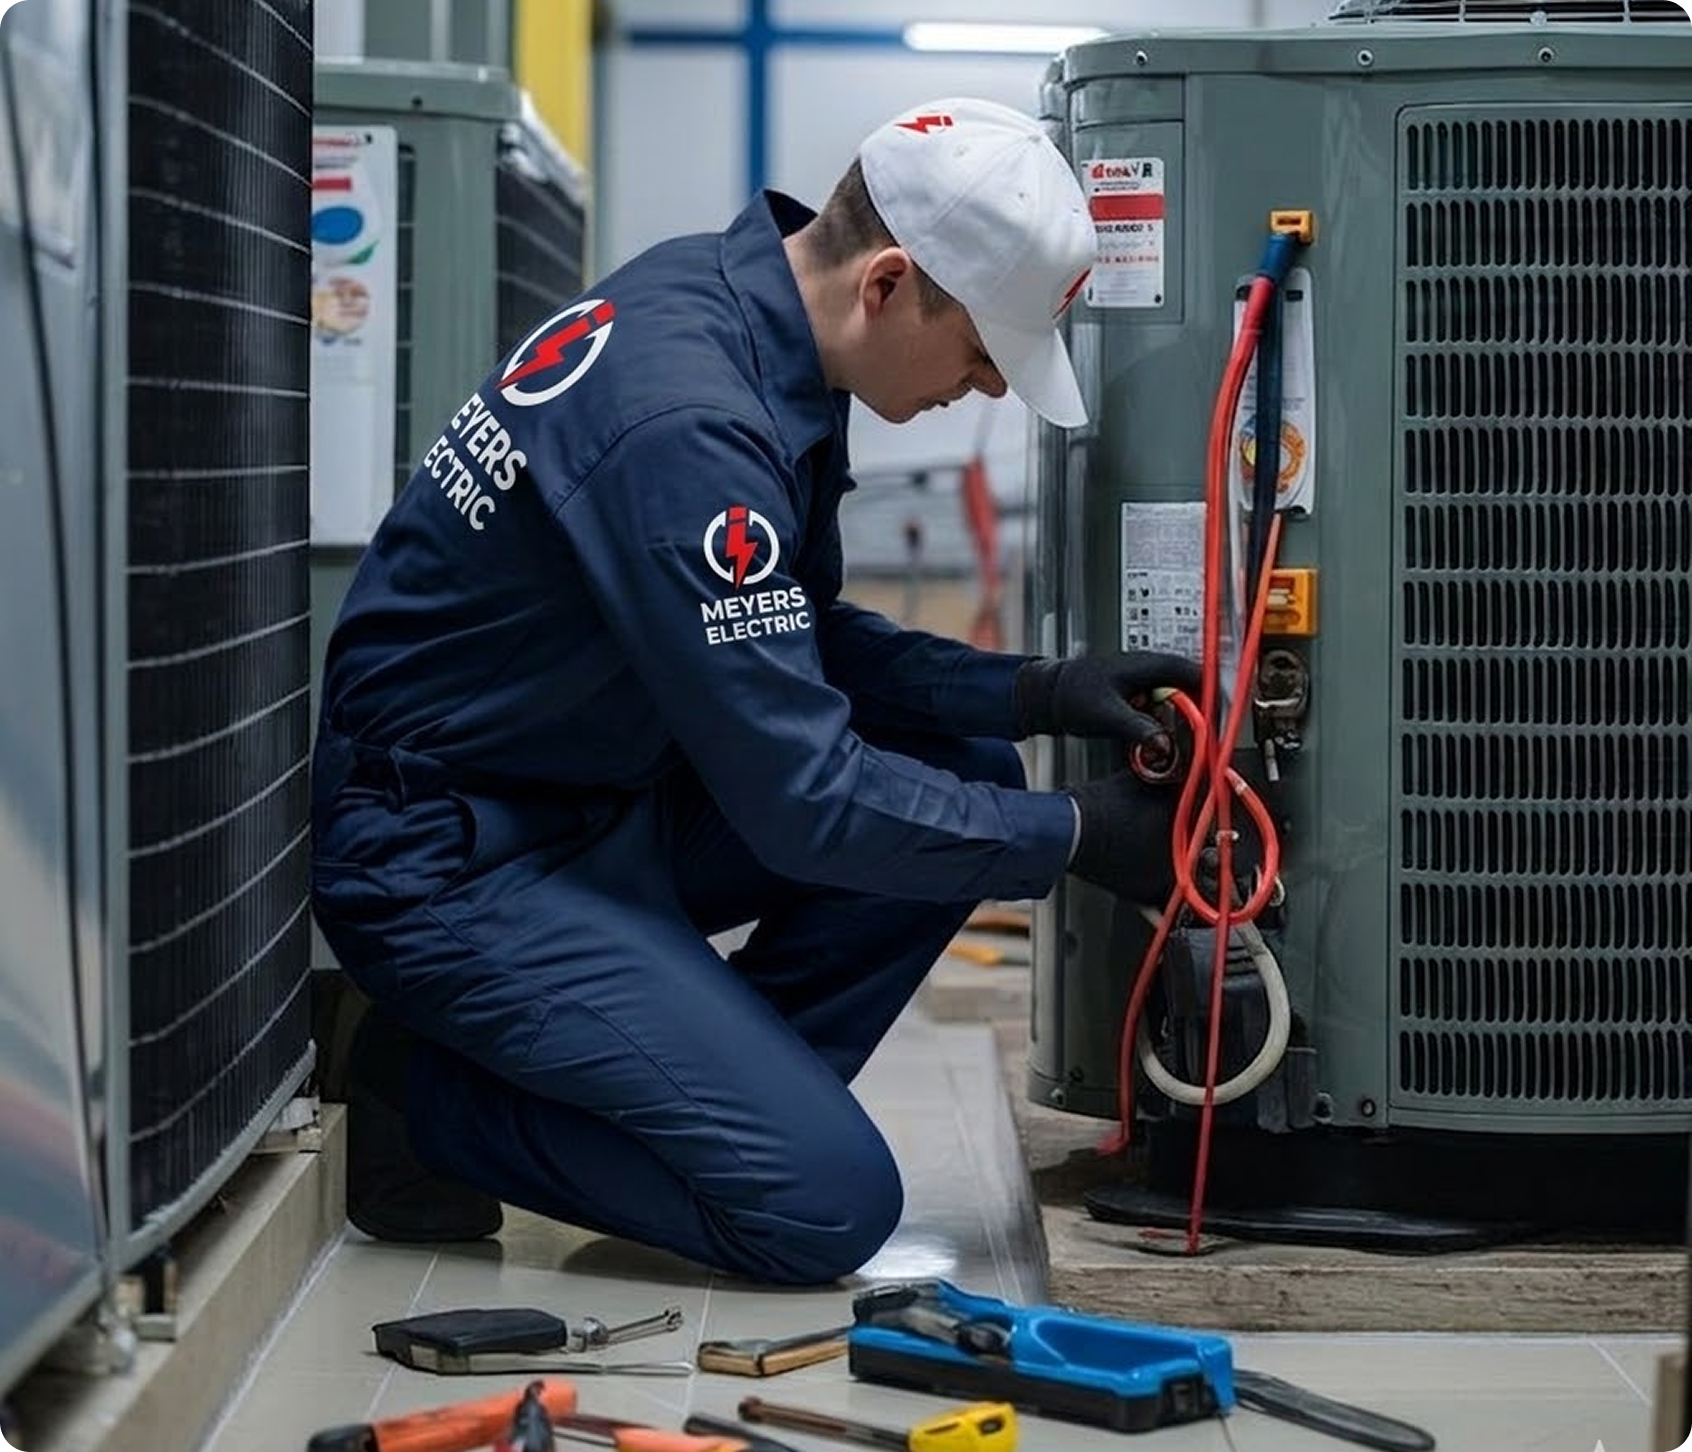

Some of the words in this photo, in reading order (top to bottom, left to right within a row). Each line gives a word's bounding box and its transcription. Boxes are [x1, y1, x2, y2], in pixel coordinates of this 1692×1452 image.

[451, 392, 527, 491] EYERS
[423, 434, 496, 531] ECTRIC
[700, 586, 806, 623] MEYERS
[705, 611, 811, 645] ELECTRIC
